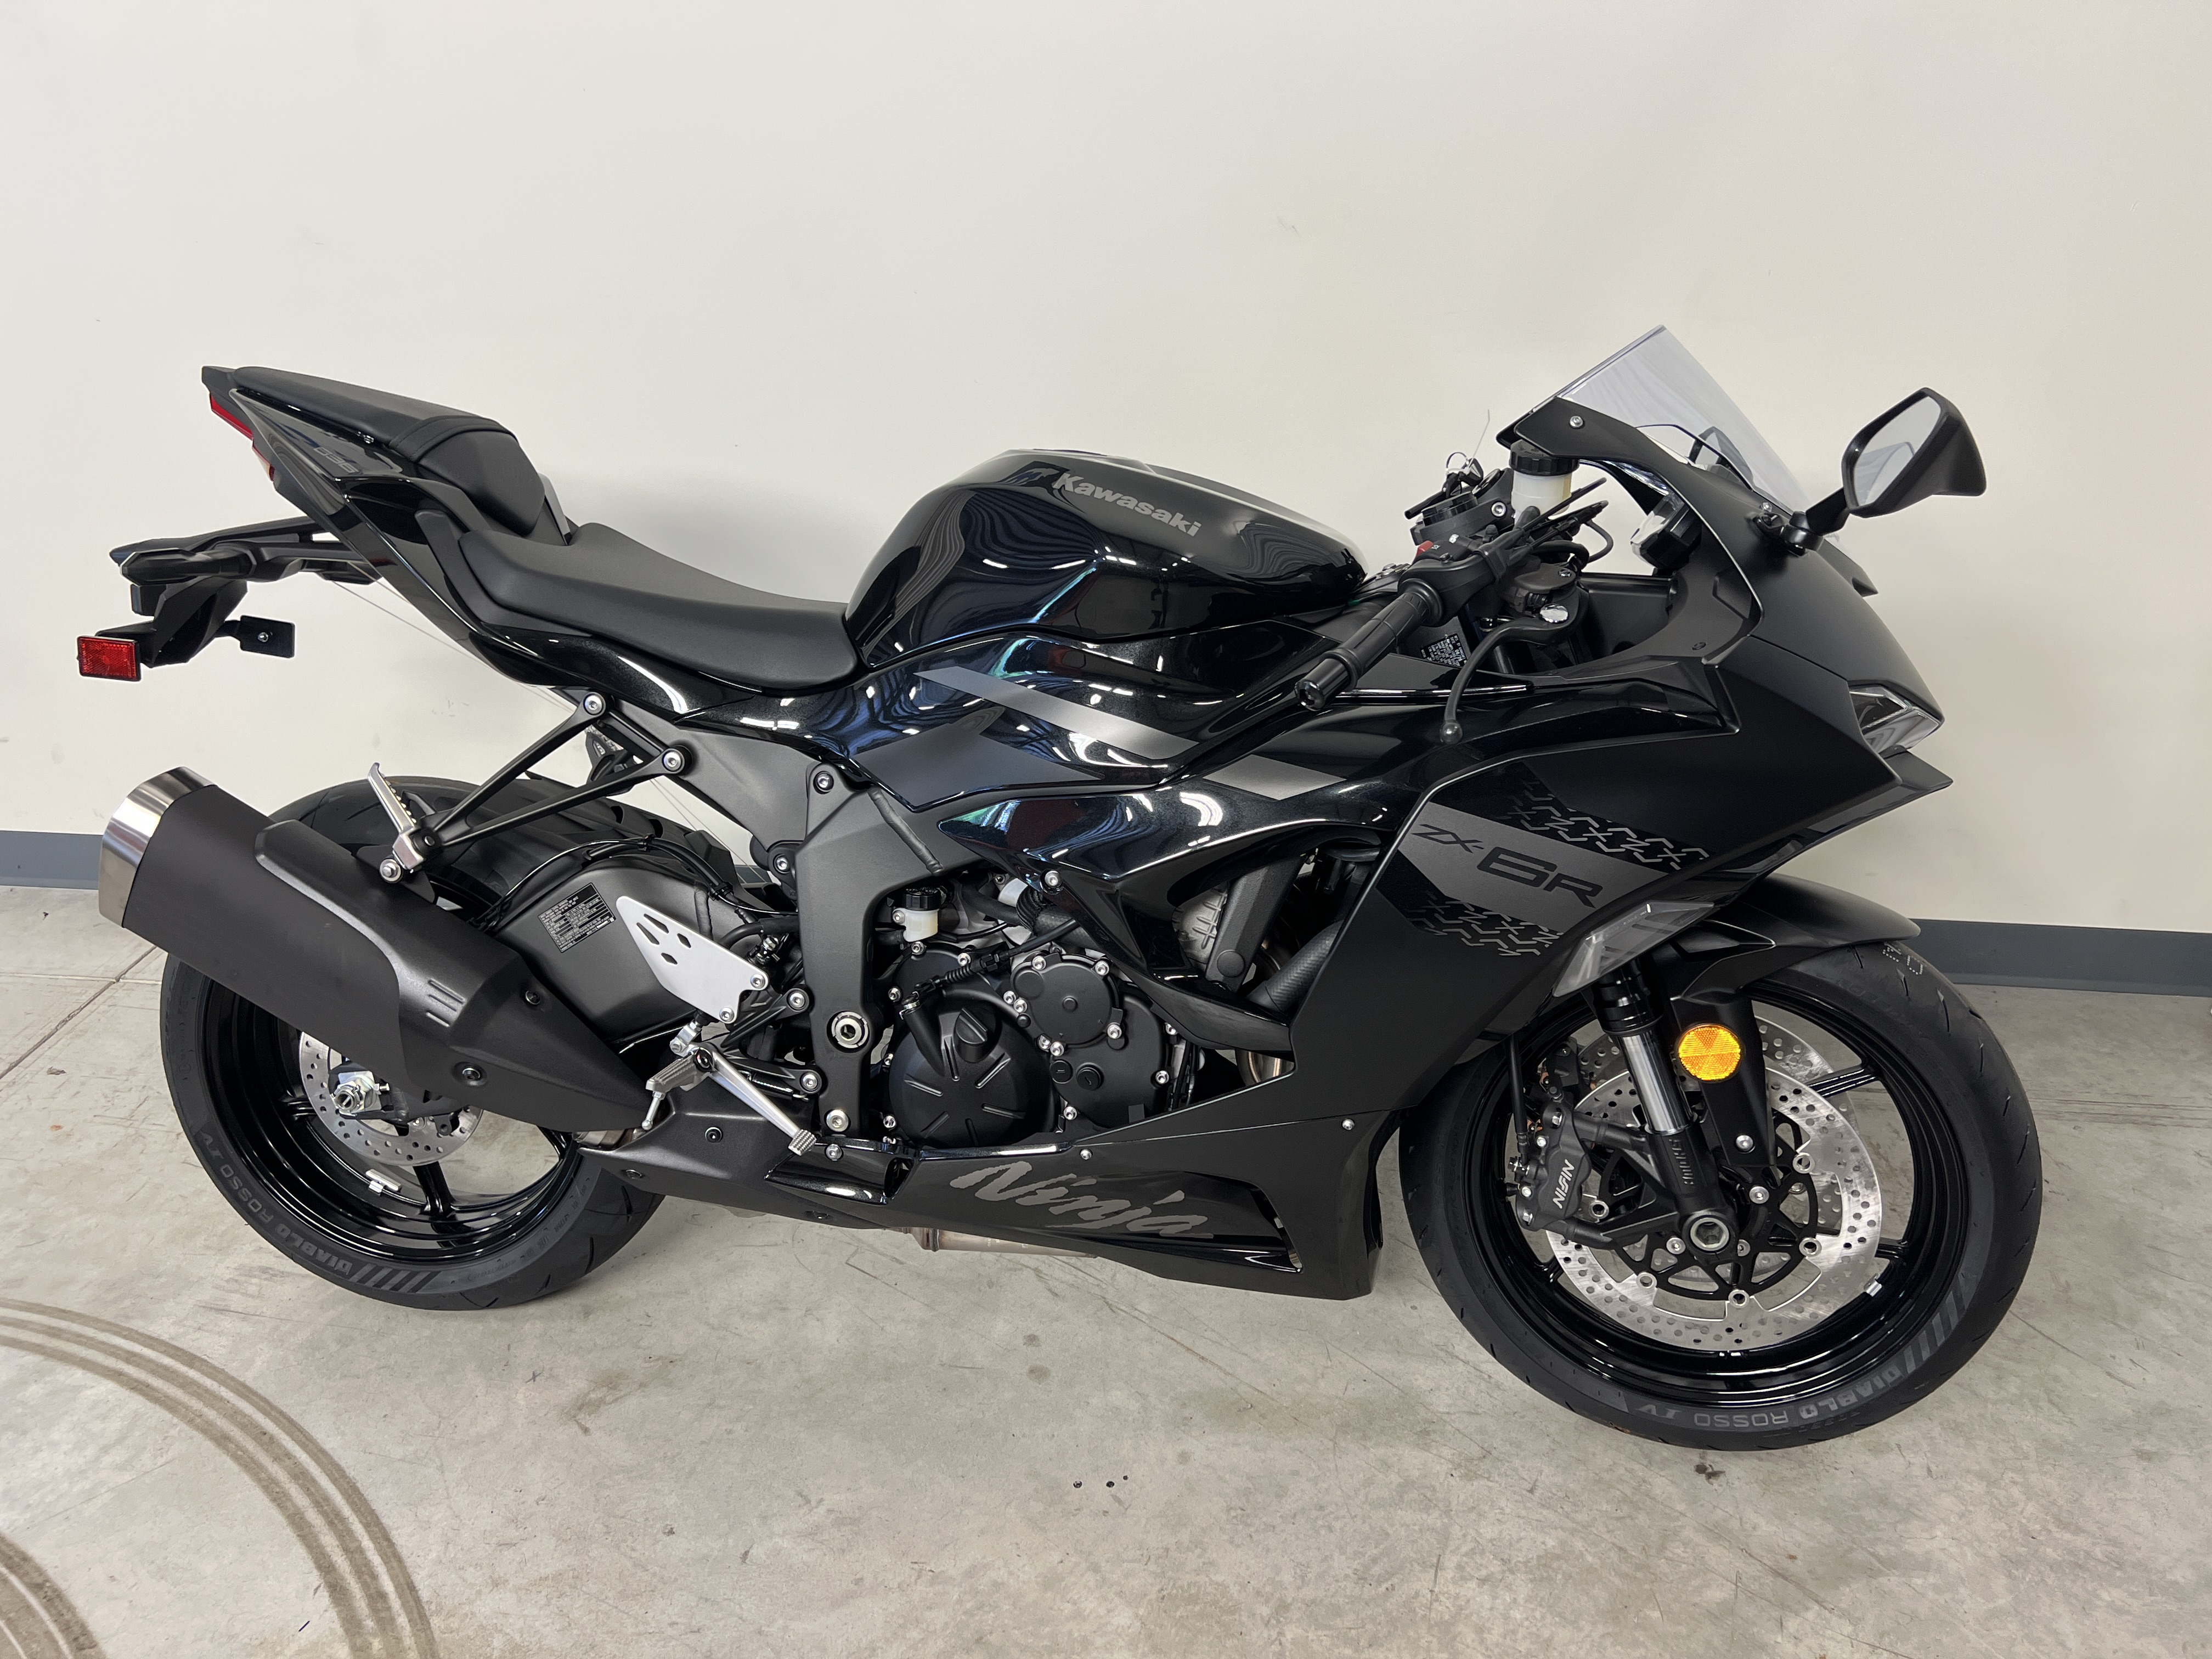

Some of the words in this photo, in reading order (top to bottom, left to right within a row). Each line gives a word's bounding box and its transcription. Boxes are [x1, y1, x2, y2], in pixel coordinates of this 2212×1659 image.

[1051, 472, 1202, 537] Kawasaki
[1410, 824, 1603, 909] ZX-6R
[220, 1164, 274, 1224] ROSSO
[950, 1161, 1214, 1239] Ninja
[1553, 1159, 1575, 1209] NISSIN
[274, 1223, 353, 1276] DIABLO
[1635, 1404, 1682, 1419] IV
[1694, 1410, 1789, 1427] ROSSO
[1798, 1363, 1904, 1419] DIABLO
